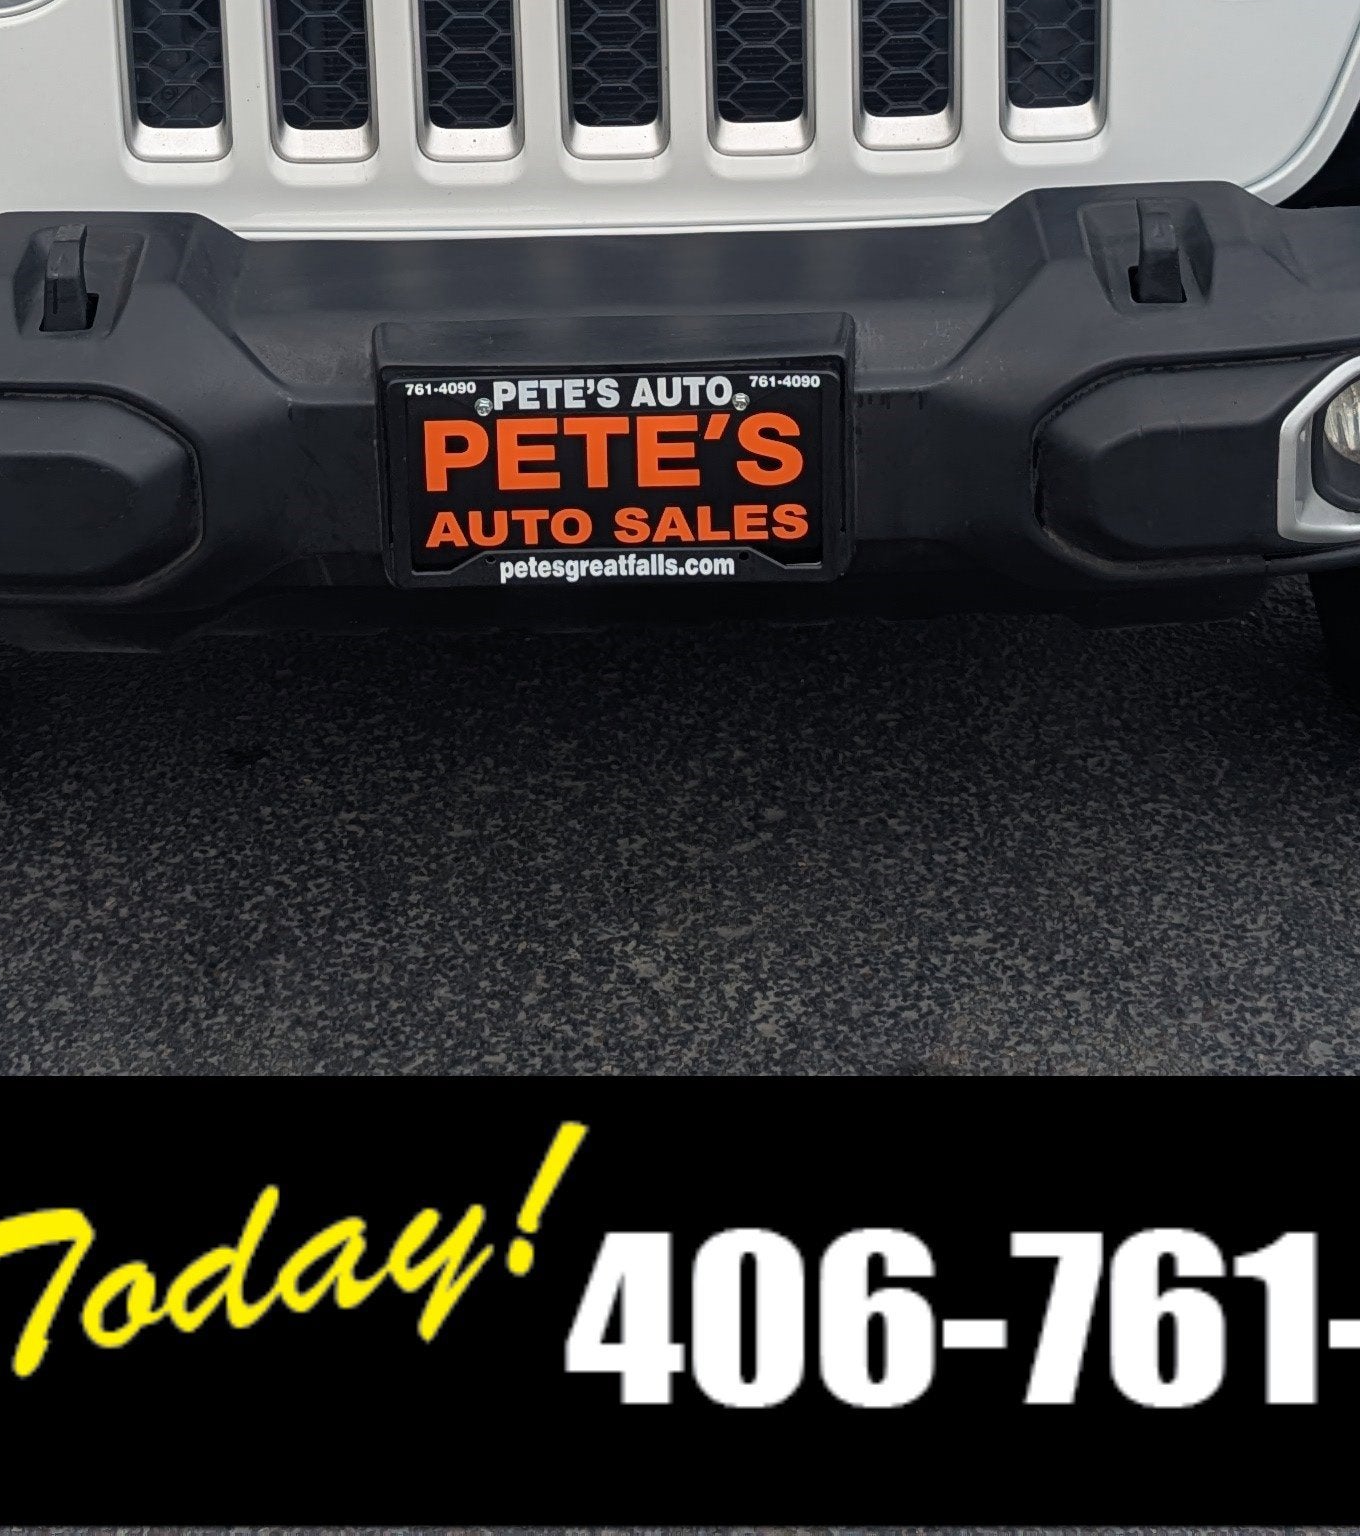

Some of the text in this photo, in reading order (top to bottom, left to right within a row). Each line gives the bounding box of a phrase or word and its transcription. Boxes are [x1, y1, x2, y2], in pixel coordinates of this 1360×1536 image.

[492, 375, 735, 411] PETE'S AUTO
[423, 412, 804, 493] PETE'S
[425, 503, 809, 548] AUTO SALES
[499, 553, 735, 584] petesgreatfalls.com
